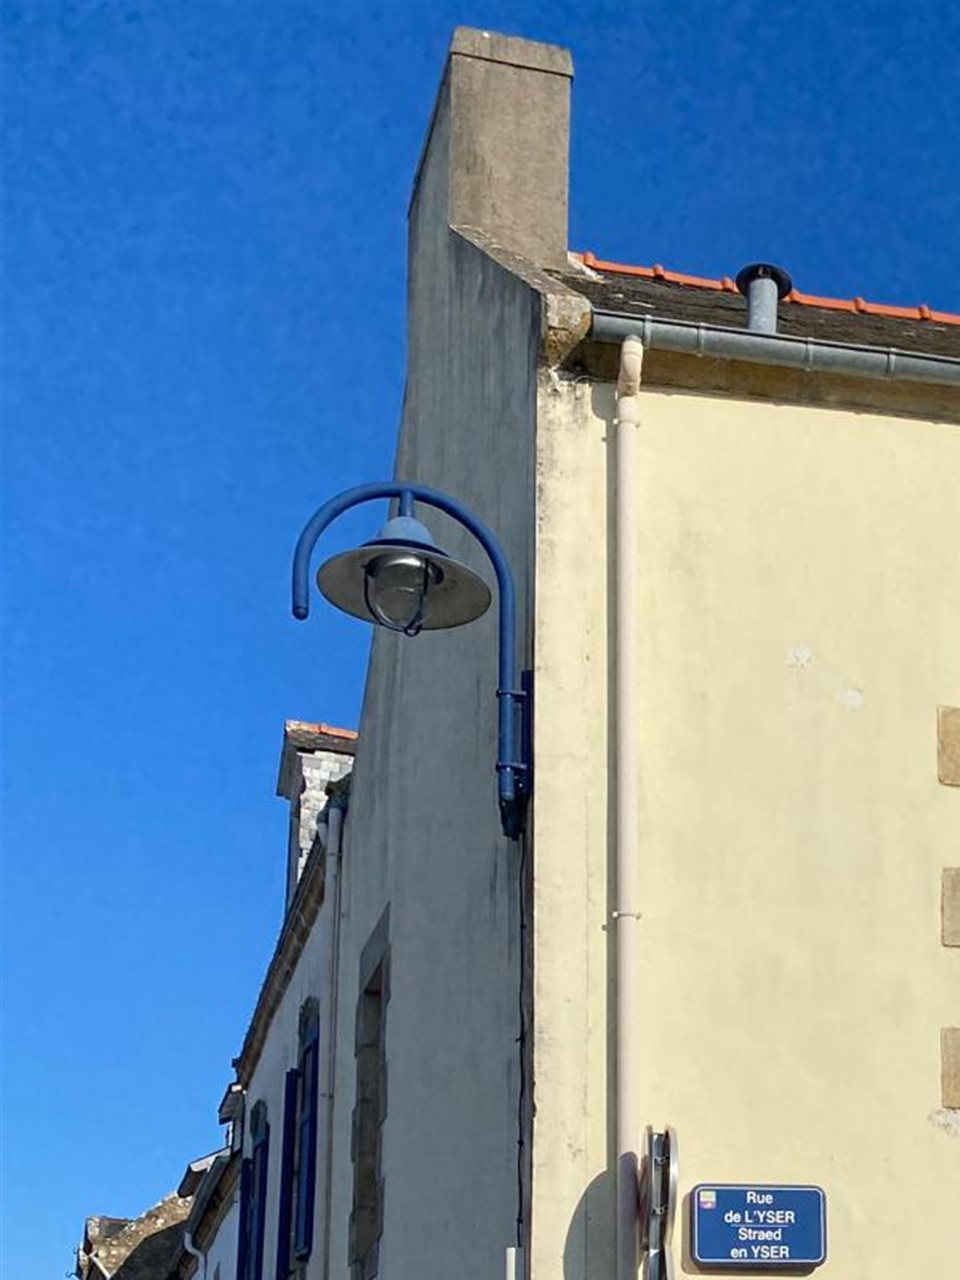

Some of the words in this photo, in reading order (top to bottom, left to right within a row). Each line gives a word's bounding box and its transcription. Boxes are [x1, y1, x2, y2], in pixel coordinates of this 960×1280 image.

[746, 1191, 774, 1205] Rue
[724, 1210, 742, 1223] de
[744, 1210, 795, 1224] L'YSER
[738, 1227, 782, 1241] Straed
[730, 1247, 748, 1259] en
[751, 1246, 790, 1259] YSER
